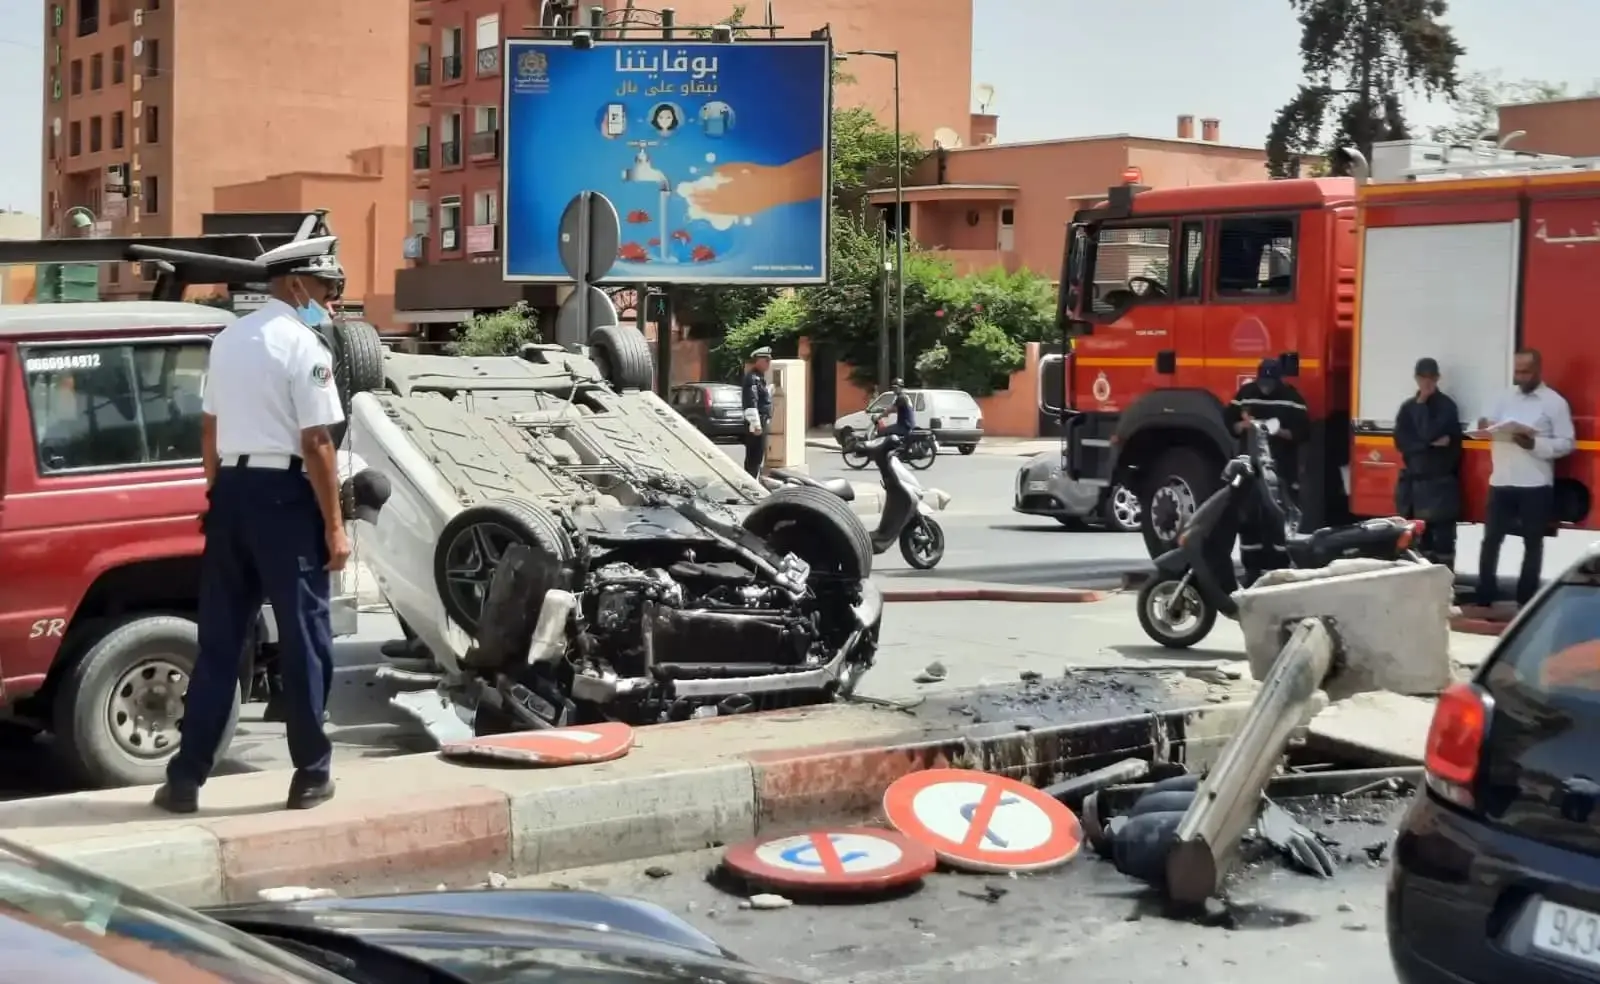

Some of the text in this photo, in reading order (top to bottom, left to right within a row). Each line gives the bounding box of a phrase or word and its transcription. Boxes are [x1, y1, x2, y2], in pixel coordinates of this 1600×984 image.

[615, 48, 718, 80] بوقايتنا
[644, 80, 674, 97] على
[30, 618, 66, 638] SR
[1549, 907, 1600, 956] 943
